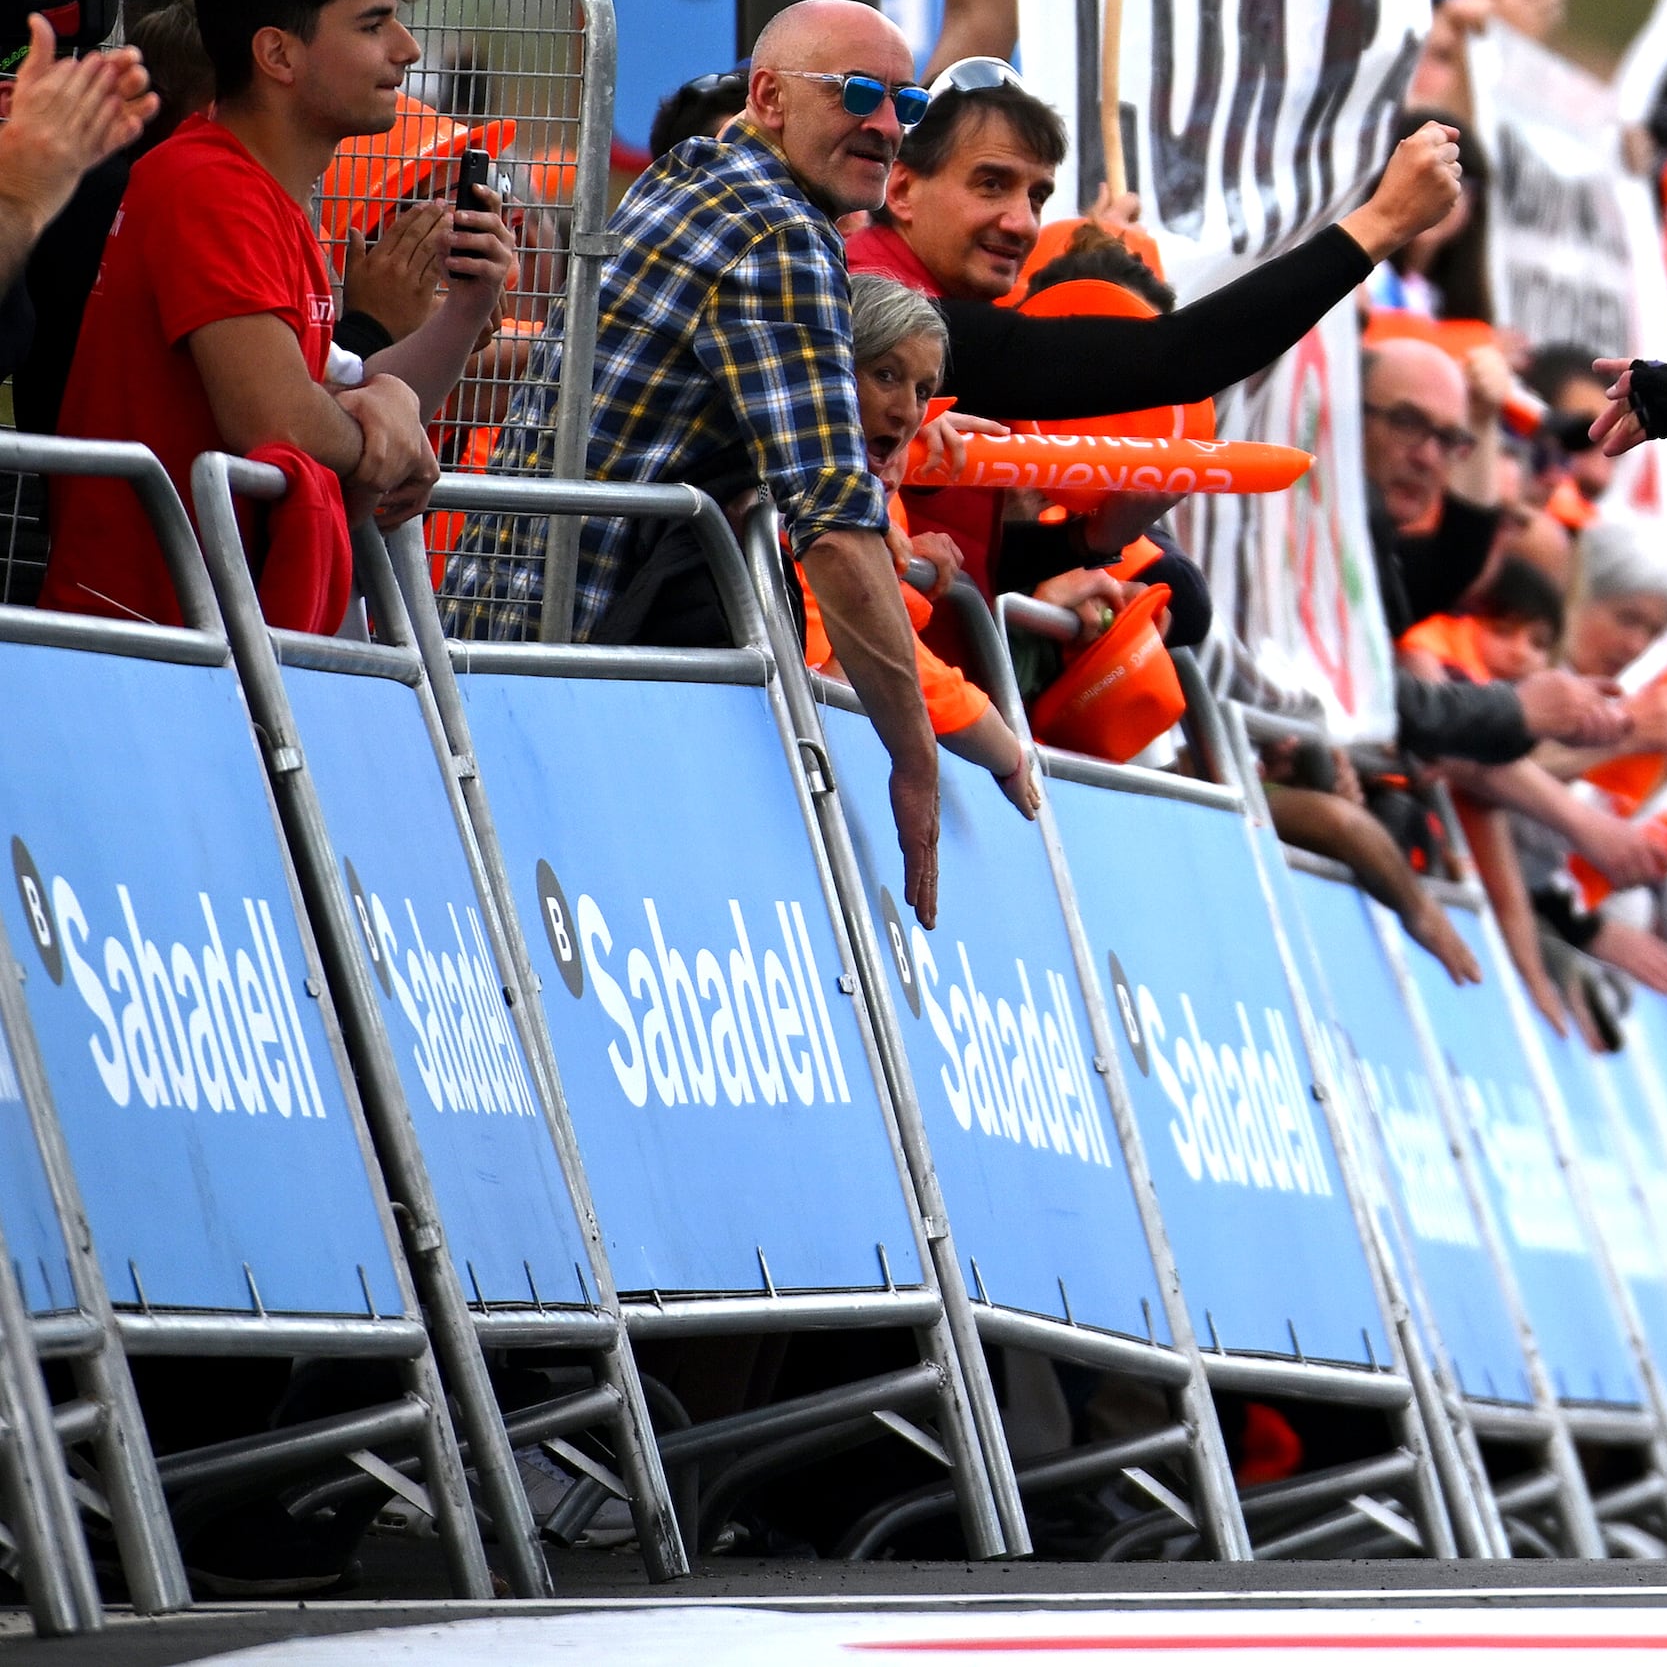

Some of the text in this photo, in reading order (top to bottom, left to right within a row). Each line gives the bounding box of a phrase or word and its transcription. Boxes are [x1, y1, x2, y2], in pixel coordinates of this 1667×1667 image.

[22, 875, 52, 947] B
[52, 875, 327, 1121] Sabadell
[354, 892, 537, 1118] B Sabadell
[546, 894, 851, 1109] B Sabadell
[889, 922, 1112, 1169] B Sabadell
[1116, 983, 1140, 1044] B
[1137, 984, 1333, 1197] Sabadell
